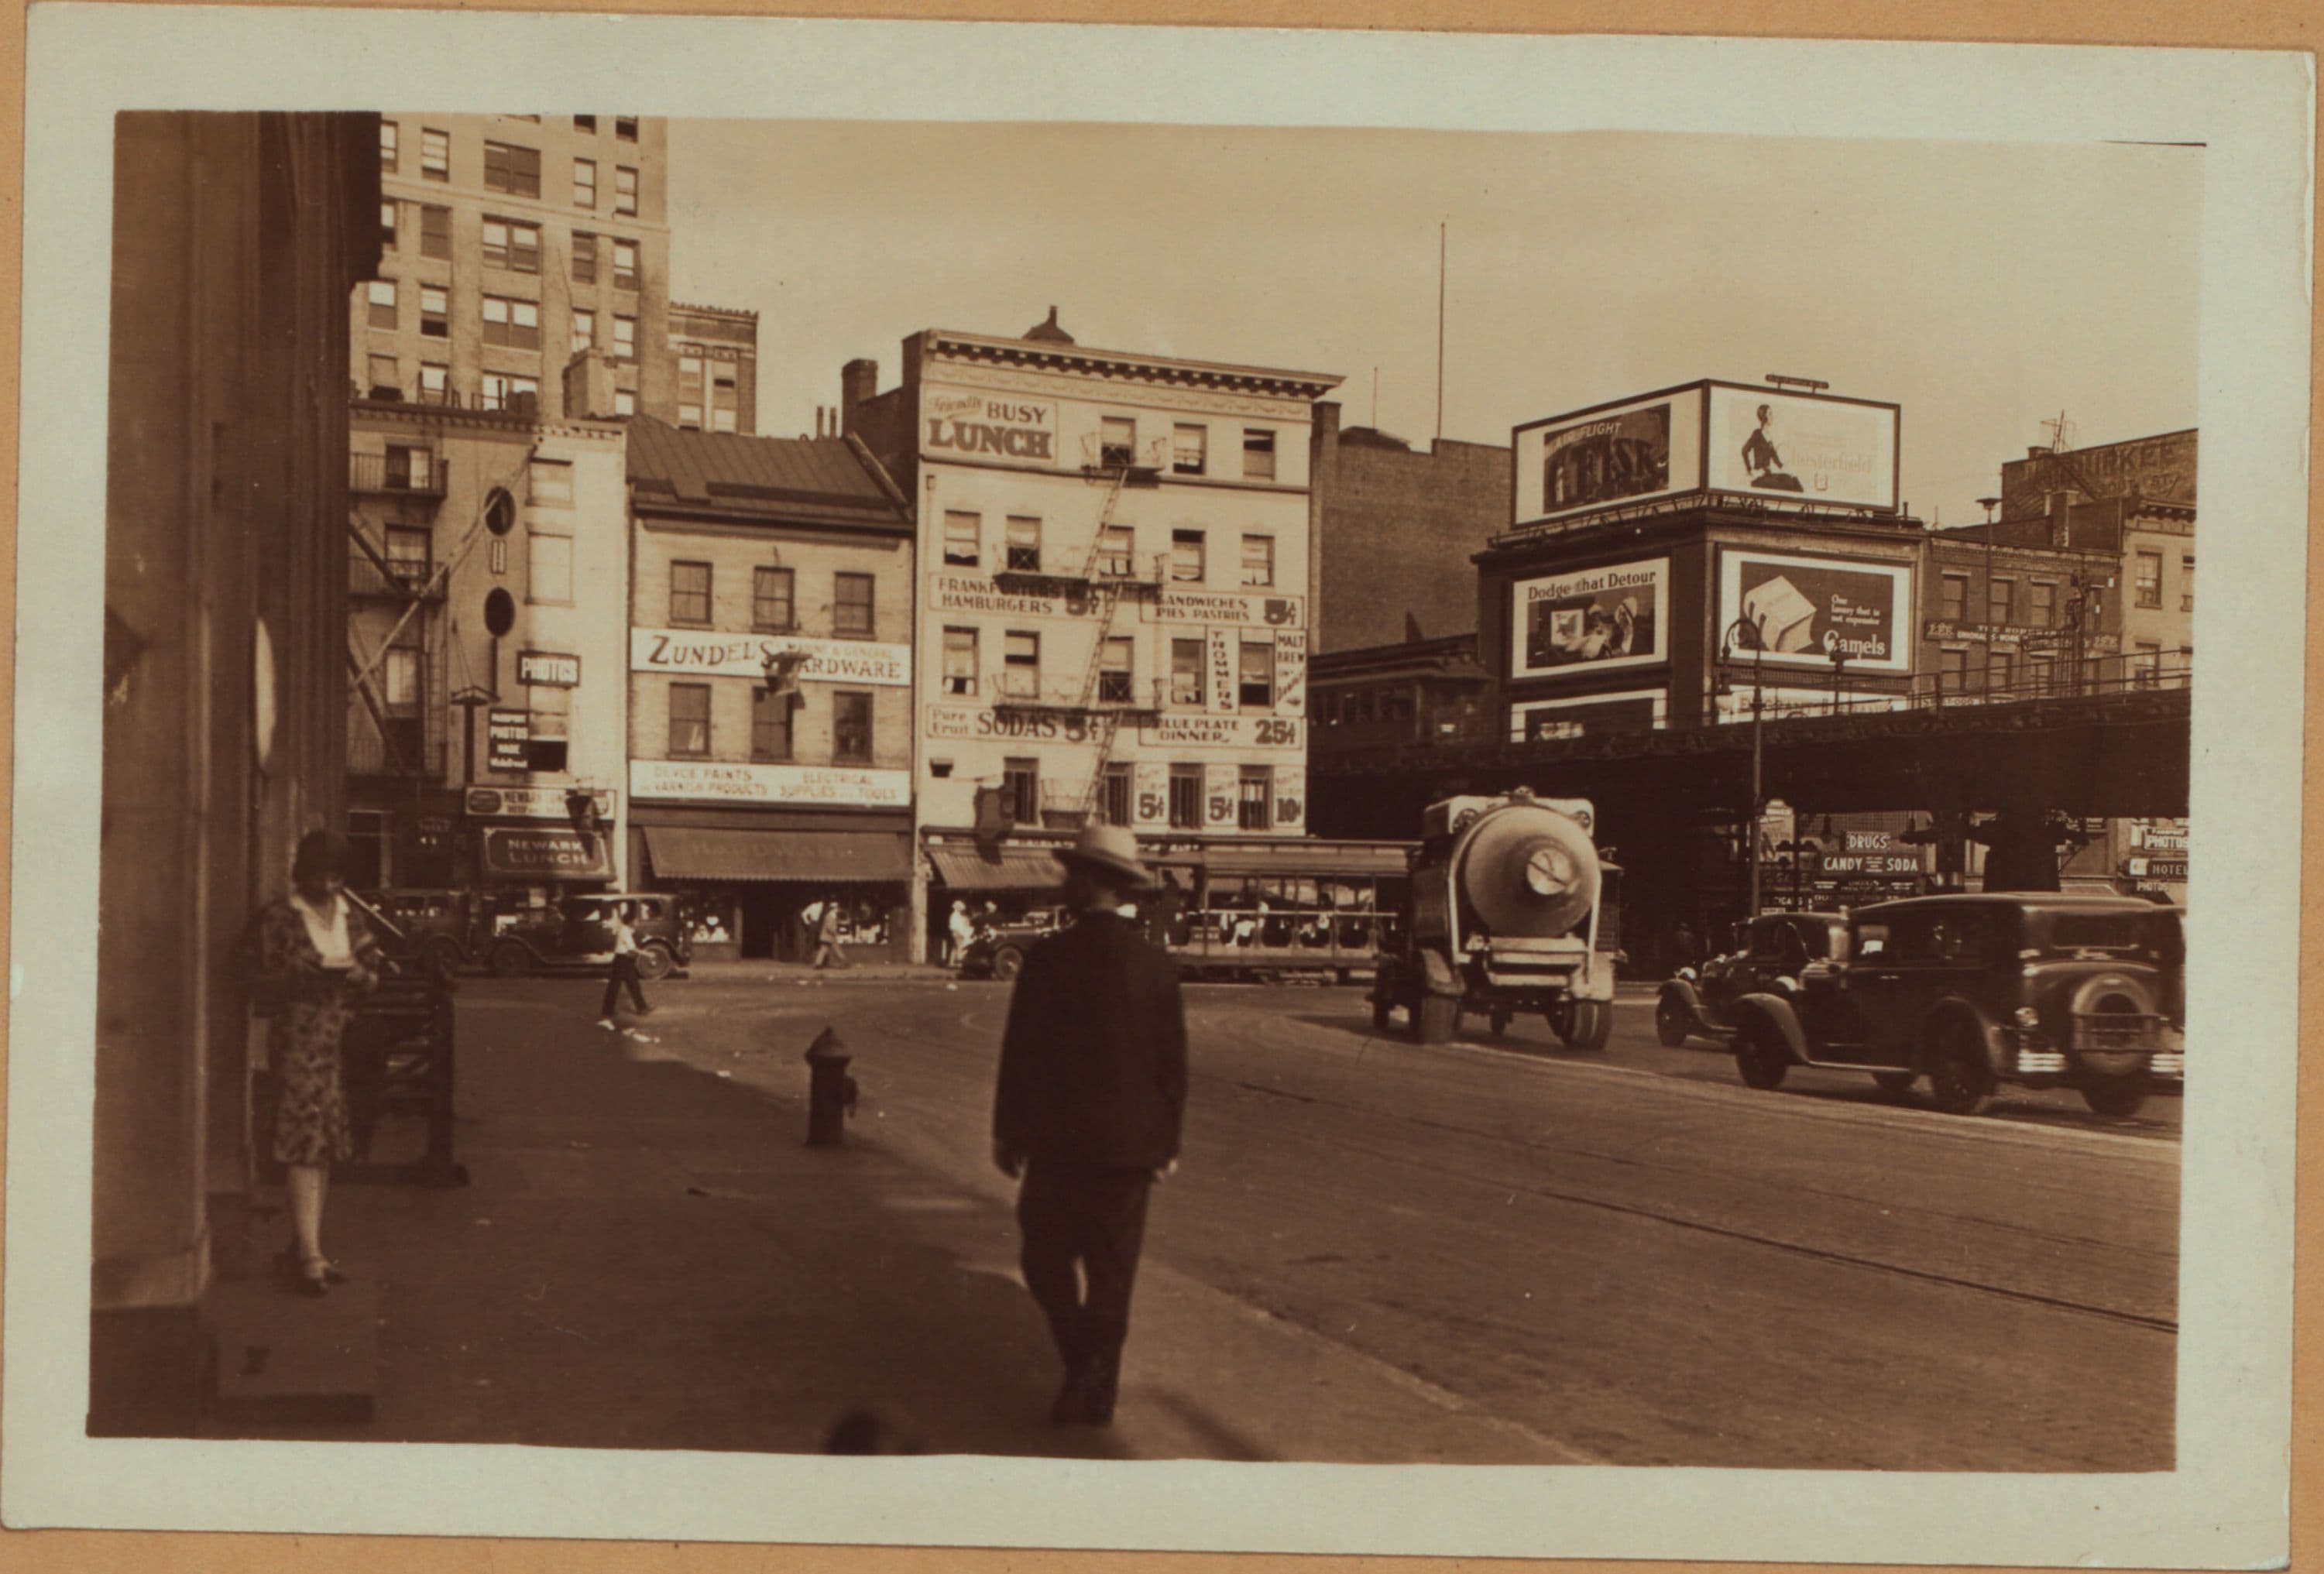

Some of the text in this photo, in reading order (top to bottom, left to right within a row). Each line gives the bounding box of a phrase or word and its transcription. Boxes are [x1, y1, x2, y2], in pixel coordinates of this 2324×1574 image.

[987, 401, 1048, 424] BUSY
[1581, 423, 1622, 437] FLIGHT
[928, 417, 1052, 460] LUNCH
[1528, 583, 1571, 602] Dodge
[1608, 571, 1656, 588] Detour
[942, 594, 1052, 615] HAMBURGERS
[1157, 607, 1251, 622] PIES PASTRIES
[1277, 635, 1305, 648] MALT
[1823, 629, 1885, 660] Camels
[521, 657, 578, 683] PHOTOS
[788, 657, 901, 679] ARDWARE
[977, 710, 1058, 739] SODAS
[1193, 718, 1240, 731] PLATE
[1159, 729, 1223, 743] DINNER
[508, 839, 584, 852] NEWARK
[1848, 835, 1889, 849] DRUGS
[508, 852, 588, 866] LUNCH
[1823, 856, 1863, 871] CANDY
[1886, 857, 1919, 872] SODA
